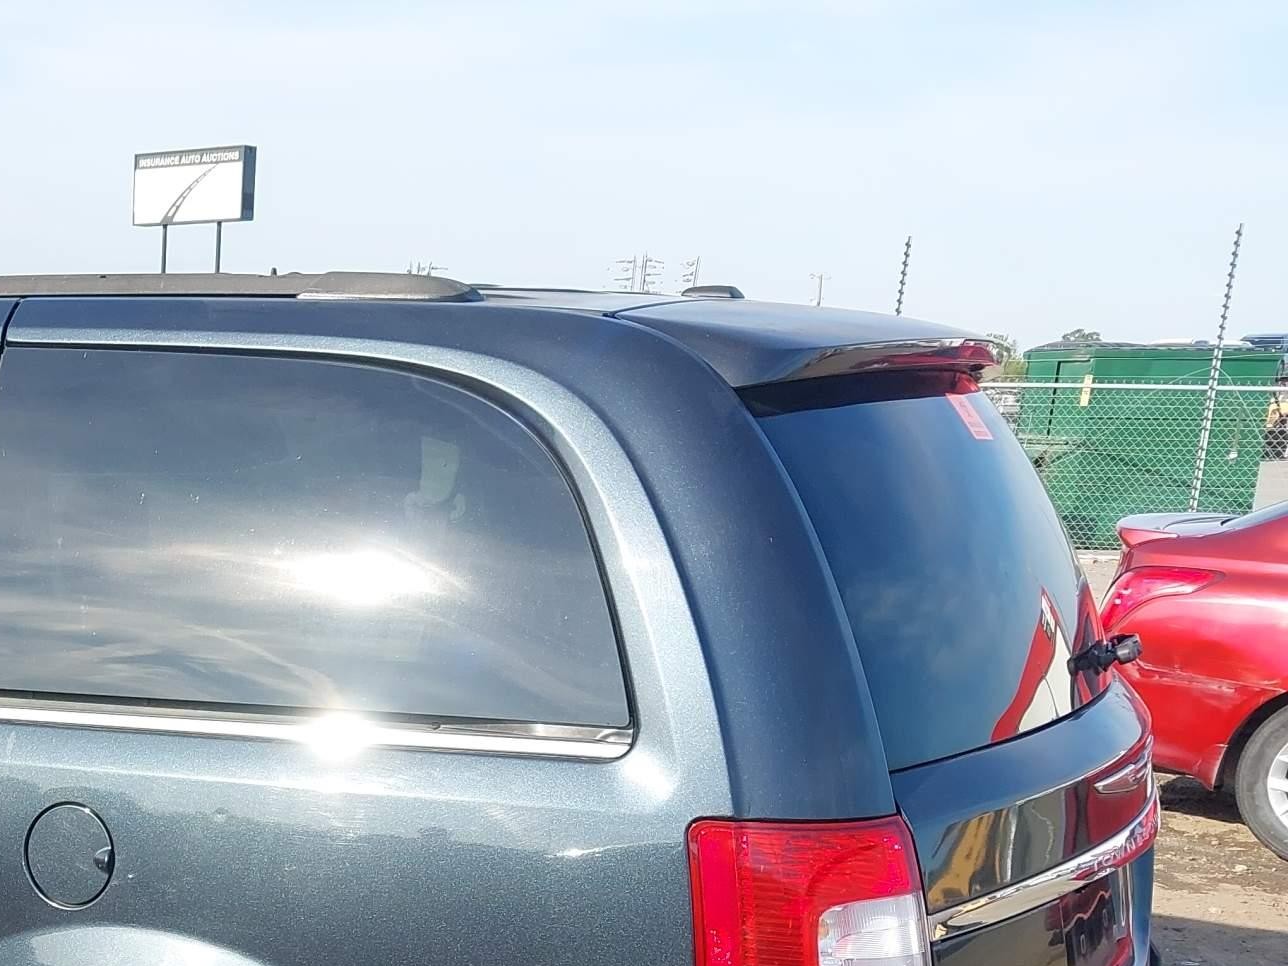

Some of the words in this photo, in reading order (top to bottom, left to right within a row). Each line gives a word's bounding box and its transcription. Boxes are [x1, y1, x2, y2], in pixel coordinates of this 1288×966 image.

[139, 155, 180, 168] INSURANCE
[180, 152, 201, 164] AUTO
[201, 150, 239, 163] AUCTIONS
